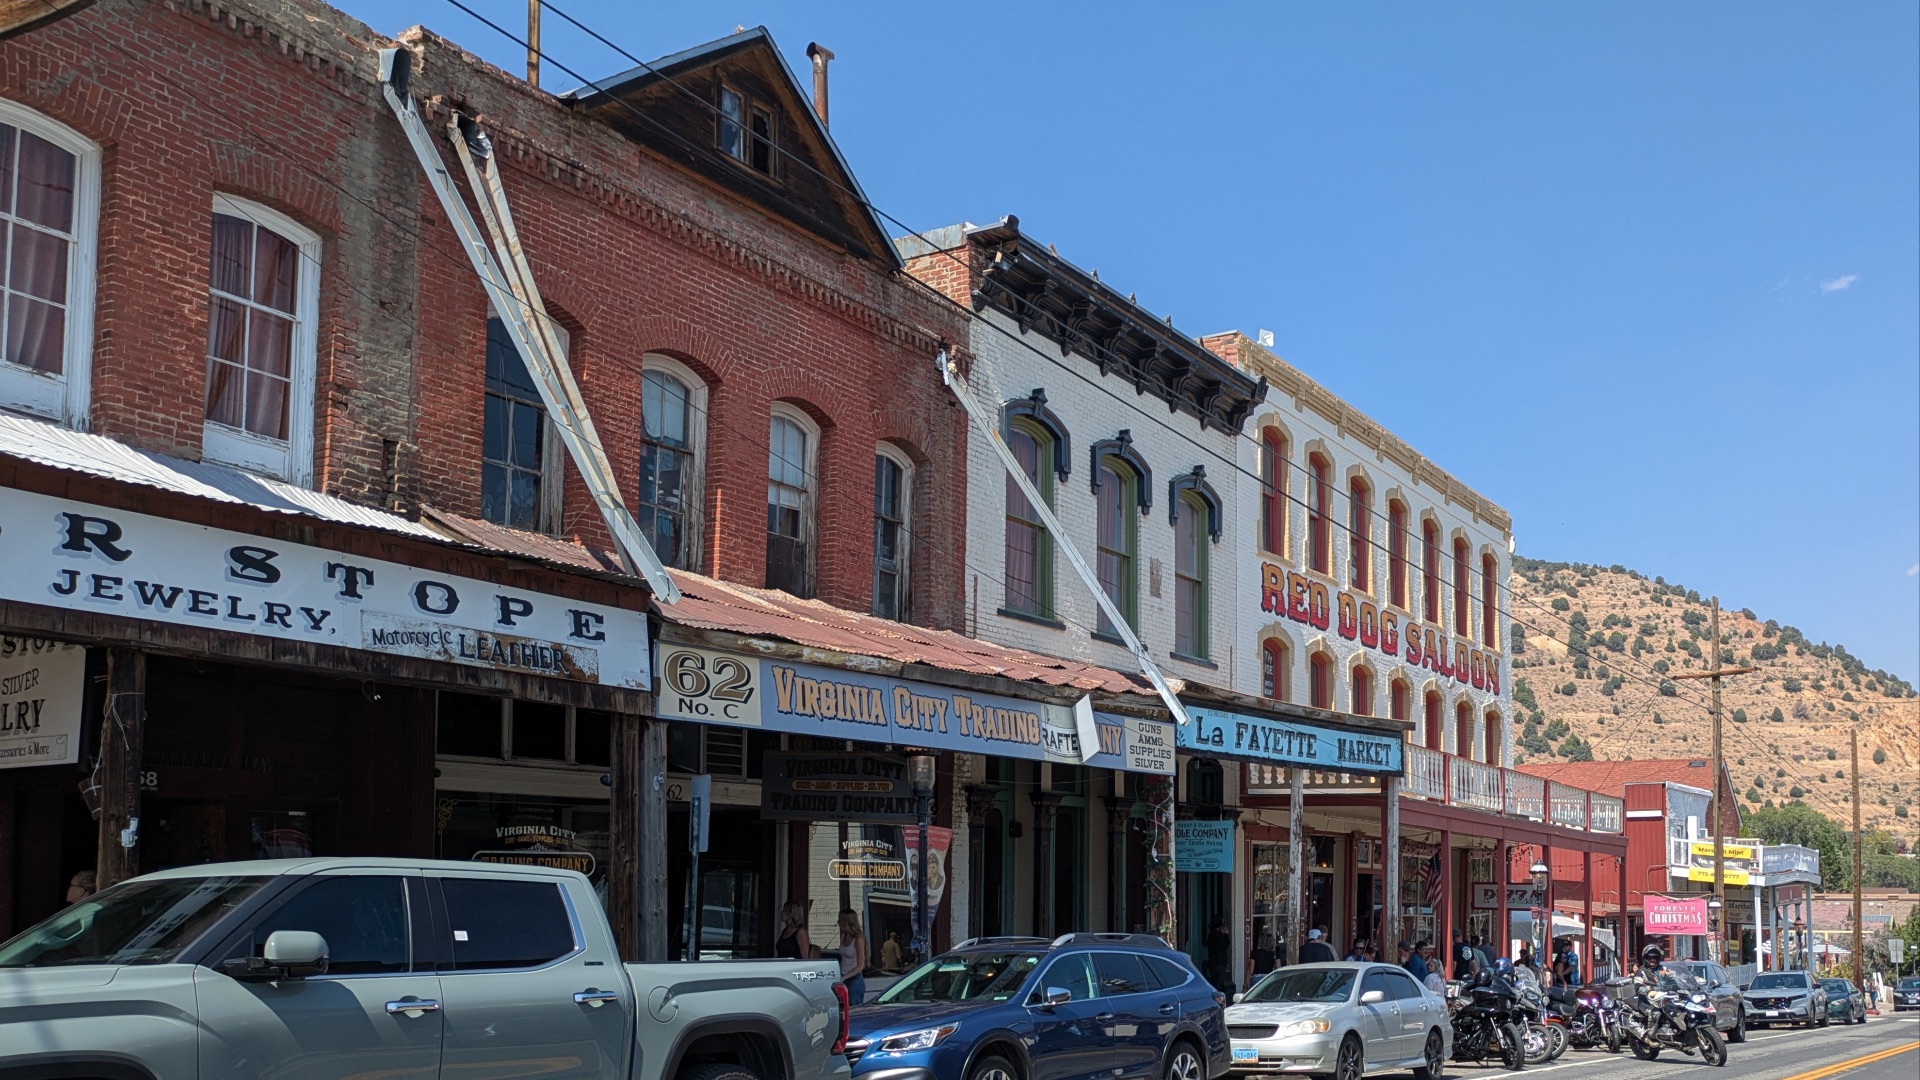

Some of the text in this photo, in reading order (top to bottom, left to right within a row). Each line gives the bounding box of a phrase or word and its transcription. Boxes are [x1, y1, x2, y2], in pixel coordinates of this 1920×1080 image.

[51, 569, 336, 635] JEWELRY,
[1261, 561, 1500, 695] RED DOG SALOON
[372, 628, 570, 675] Motorcycle LEATHER
[1, 667, 40, 696] SILVER
[664, 651, 755, 704] 62
[678, 698, 740, 719] No. C
[772, 665, 887, 726] VIRGINIA
[892, 685, 949, 735] CITY
[952, 695, 1041, 745] TRADING
[1138, 722, 1162, 735] GUNS
[1137, 734, 1164, 747] AMMO
[1196, 715, 1392, 767] La FAYETTE MARKET
[1129, 744, 1172, 760] SUPPLIES
[1134, 757, 1165, 770] SILVER
[667, 784, 683, 801] 62
[495, 825, 577, 840] VIRGINIA CITY
[1192, 828, 1229, 840] COMPANY
[842, 840, 893, 851] VIRGINIA CITY
[833, 864, 901, 876] TRADING COMPANY
[1483, 889, 1541, 905] PZZA
[1649, 911, 1702, 925] CHRISTMAS
[792, 971, 816, 981] TRD
